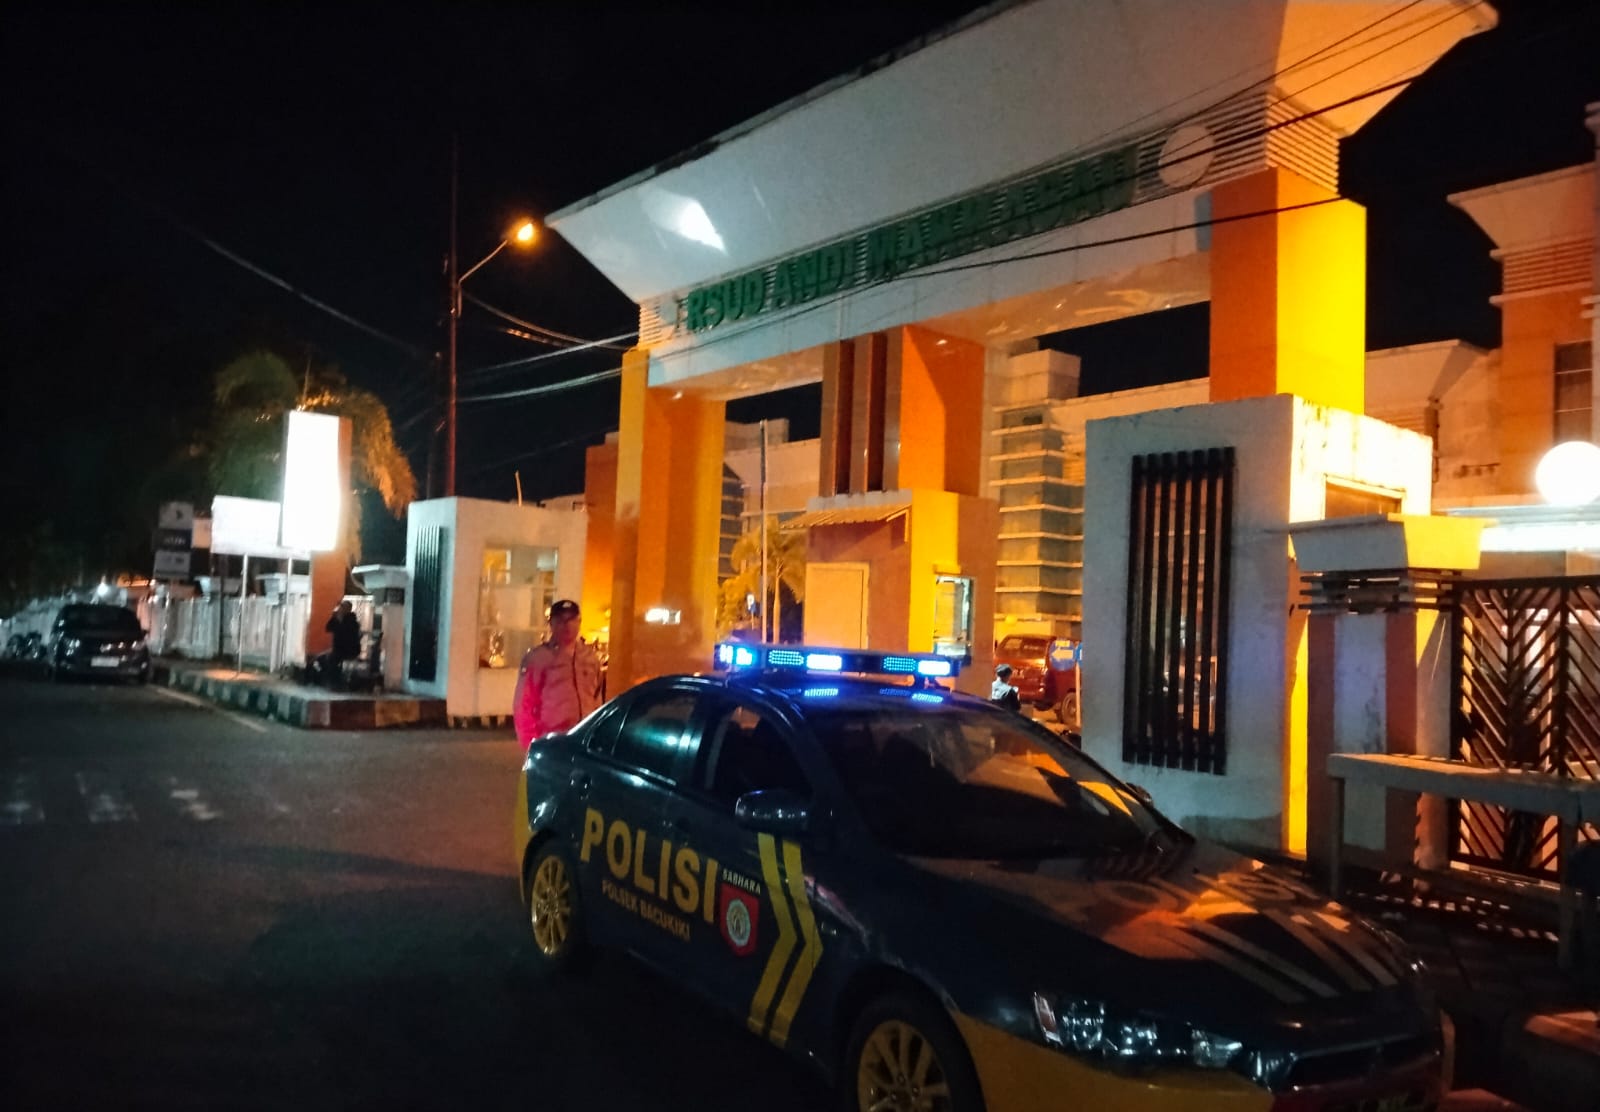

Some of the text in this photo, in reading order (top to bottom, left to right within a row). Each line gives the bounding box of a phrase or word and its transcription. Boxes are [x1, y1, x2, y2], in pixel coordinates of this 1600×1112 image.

[687, 269, 766, 331] RSUD
[773, 241, 856, 308] ANDI
[580, 806, 718, 924] POLISI
[602, 879, 638, 913] POLSEK
[722, 868, 761, 896] SABHARA
